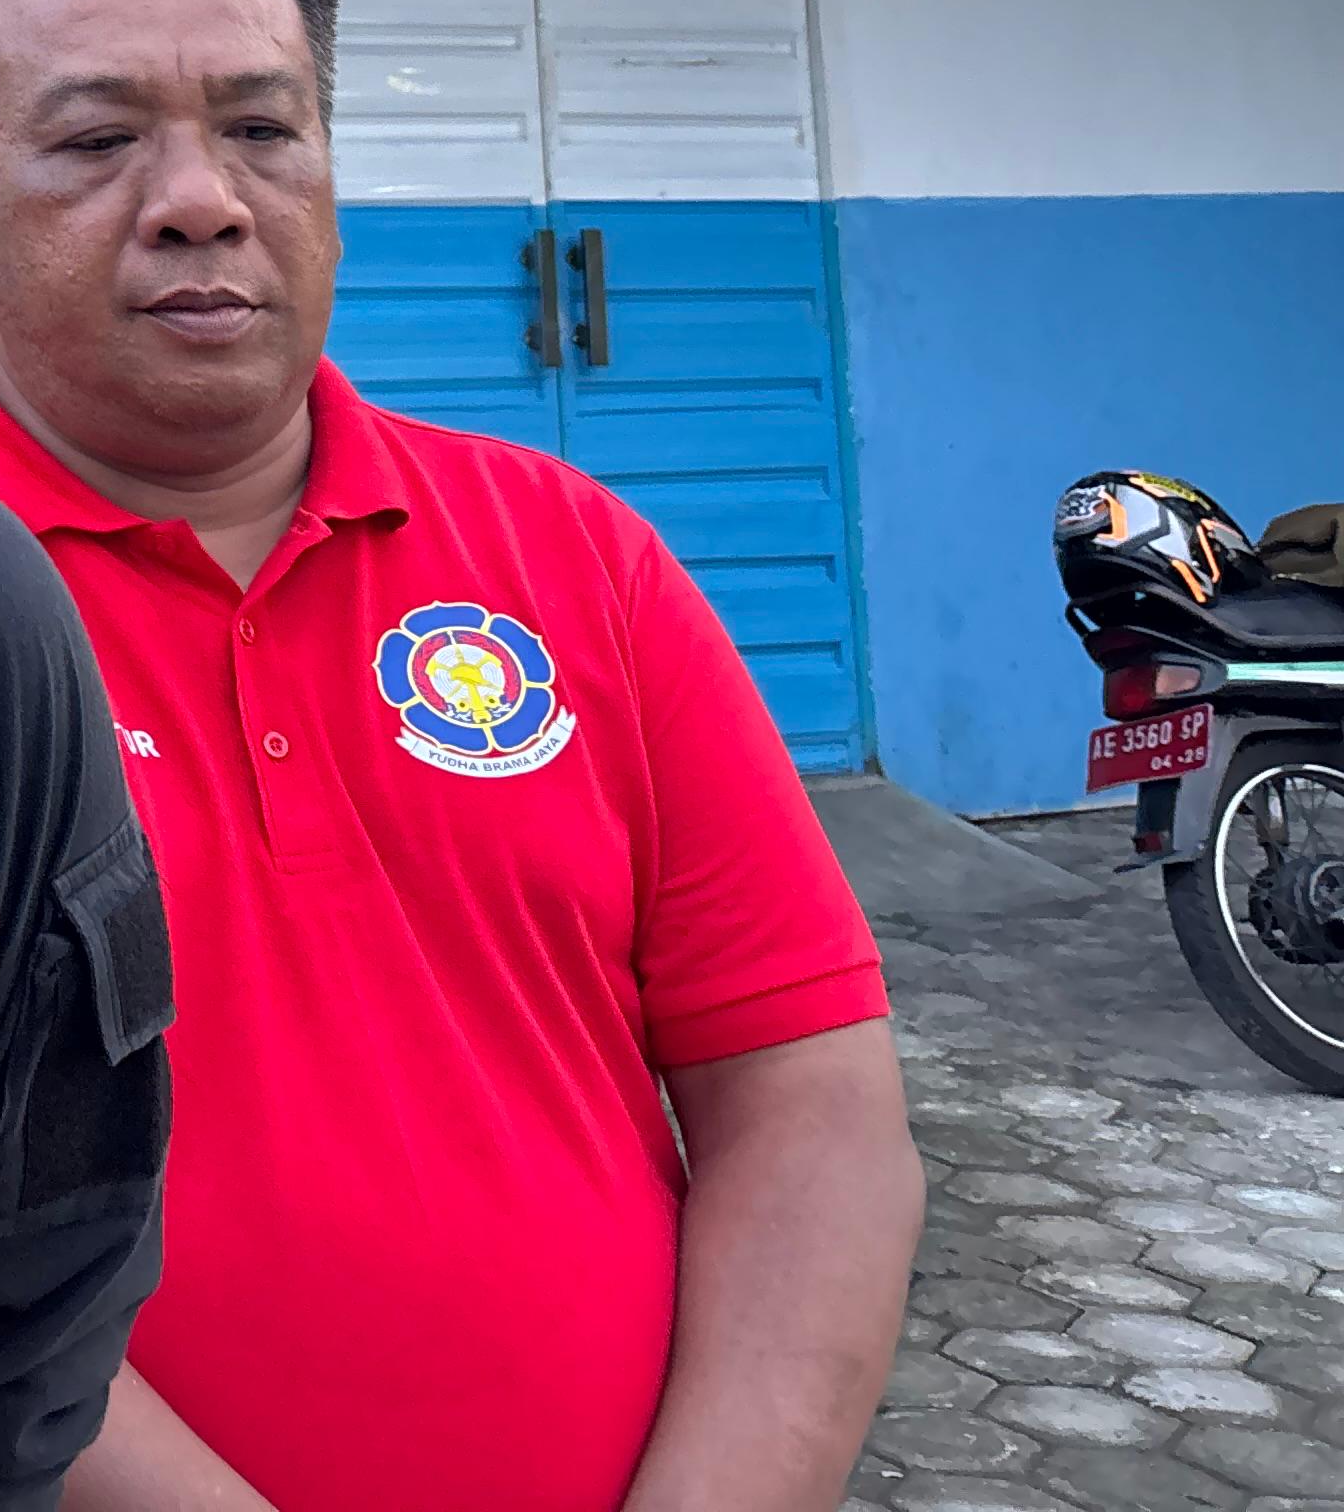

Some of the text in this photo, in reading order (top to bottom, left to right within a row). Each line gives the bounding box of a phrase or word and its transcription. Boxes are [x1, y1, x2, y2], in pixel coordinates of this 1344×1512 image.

[428, 750, 478, 771] YUDHA
[534, 737, 561, 762] JAYA
[1093, 732, 1117, 760] AE
[1122, 721, 1172, 752] 3560
